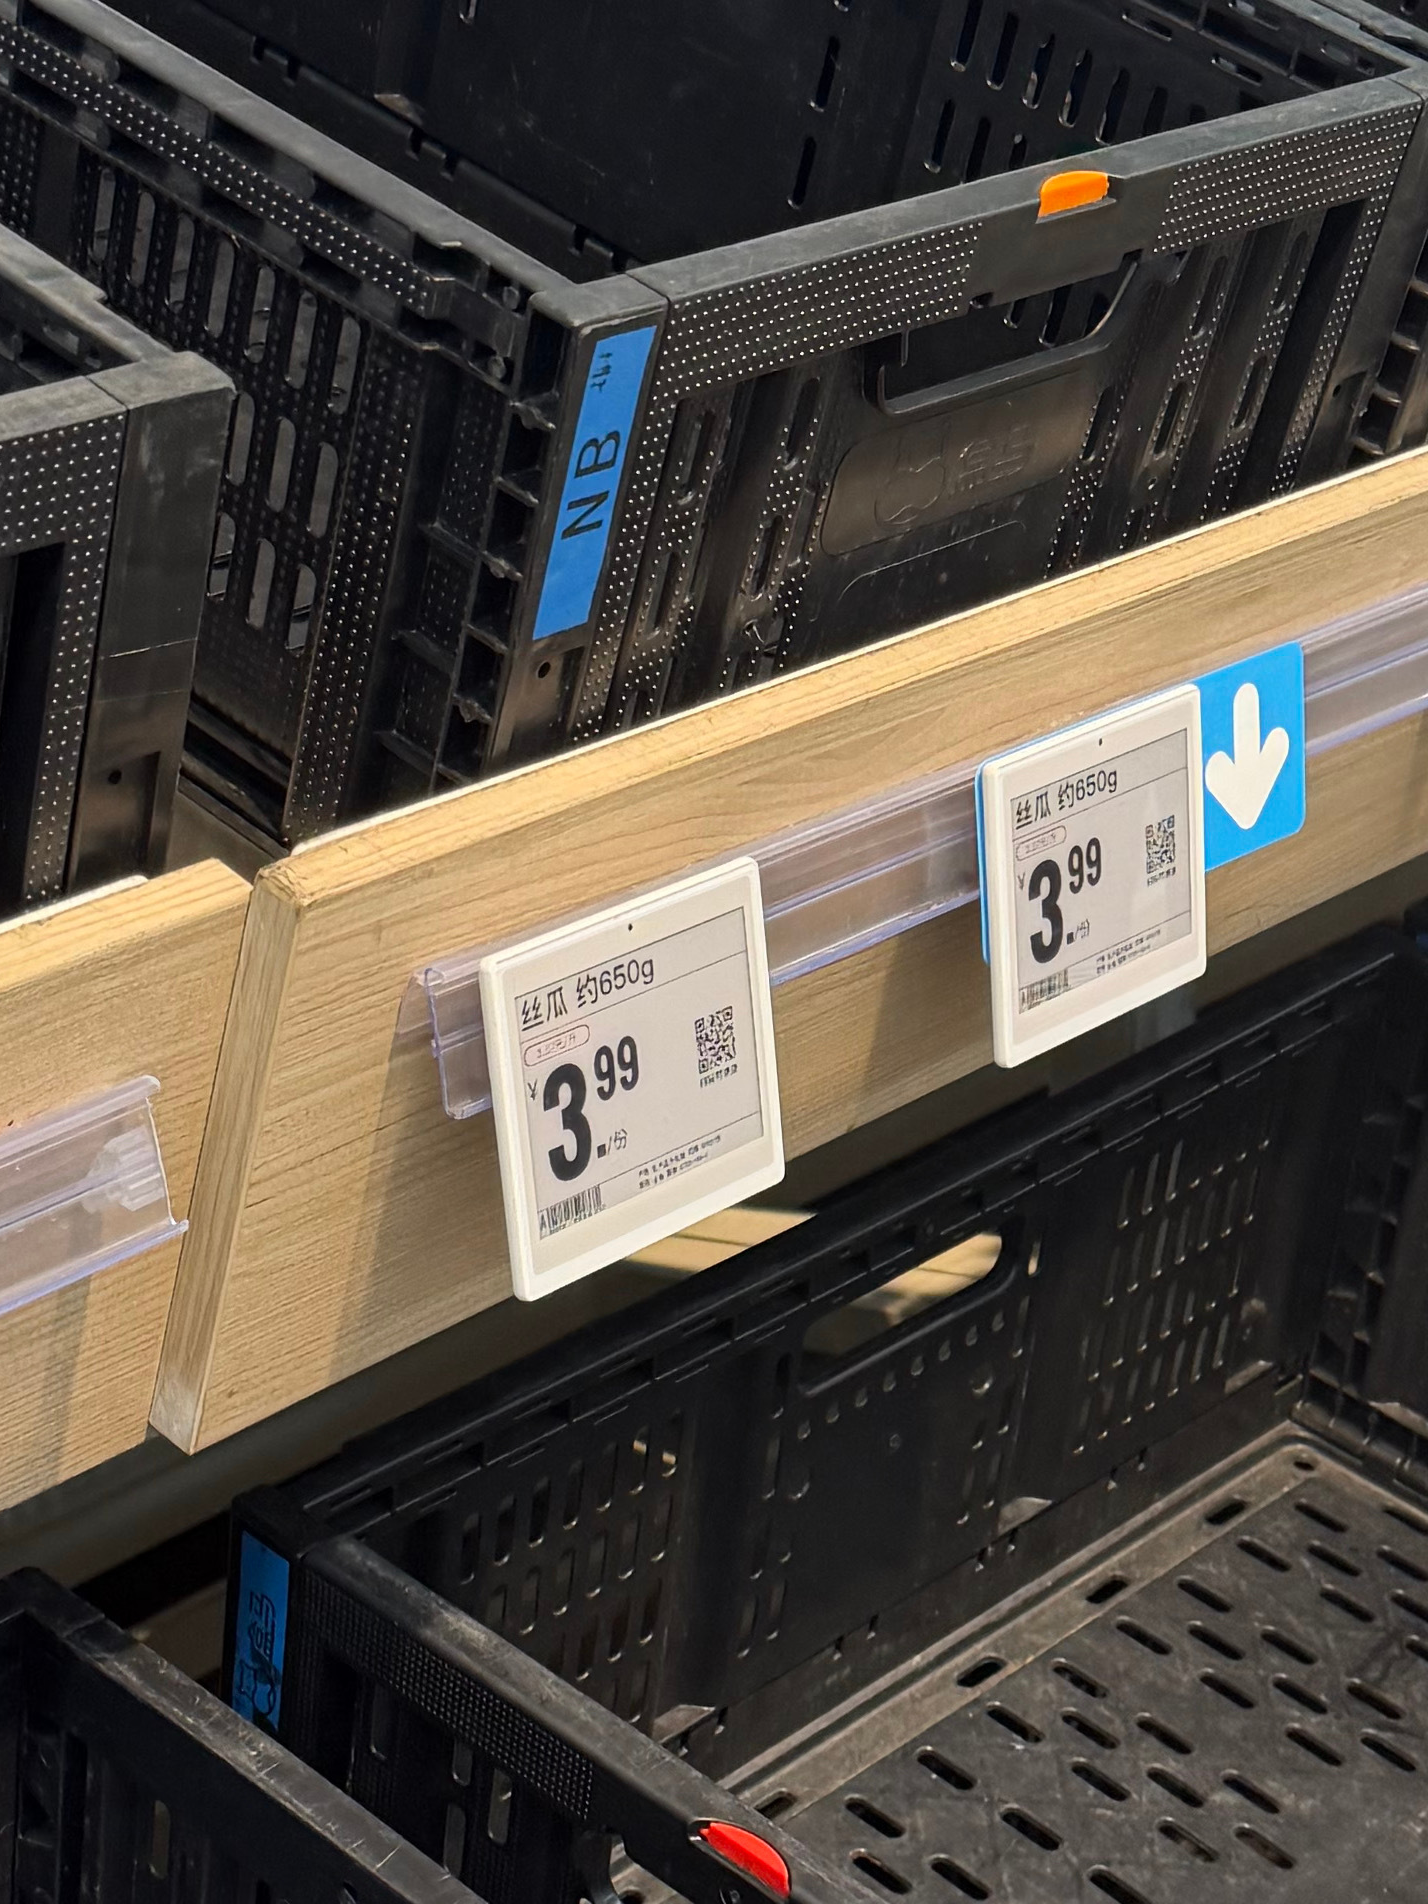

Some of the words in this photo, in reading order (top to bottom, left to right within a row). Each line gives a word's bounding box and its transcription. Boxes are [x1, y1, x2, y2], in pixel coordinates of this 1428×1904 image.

[561, 429, 620, 540] NB
[1016, 793, 1051, 831] 丝瓜
[1058, 769, 1118, 810] 约650g
[520, 986, 569, 1032] 丝瓜
[576, 959, 655, 1009] 约650g
